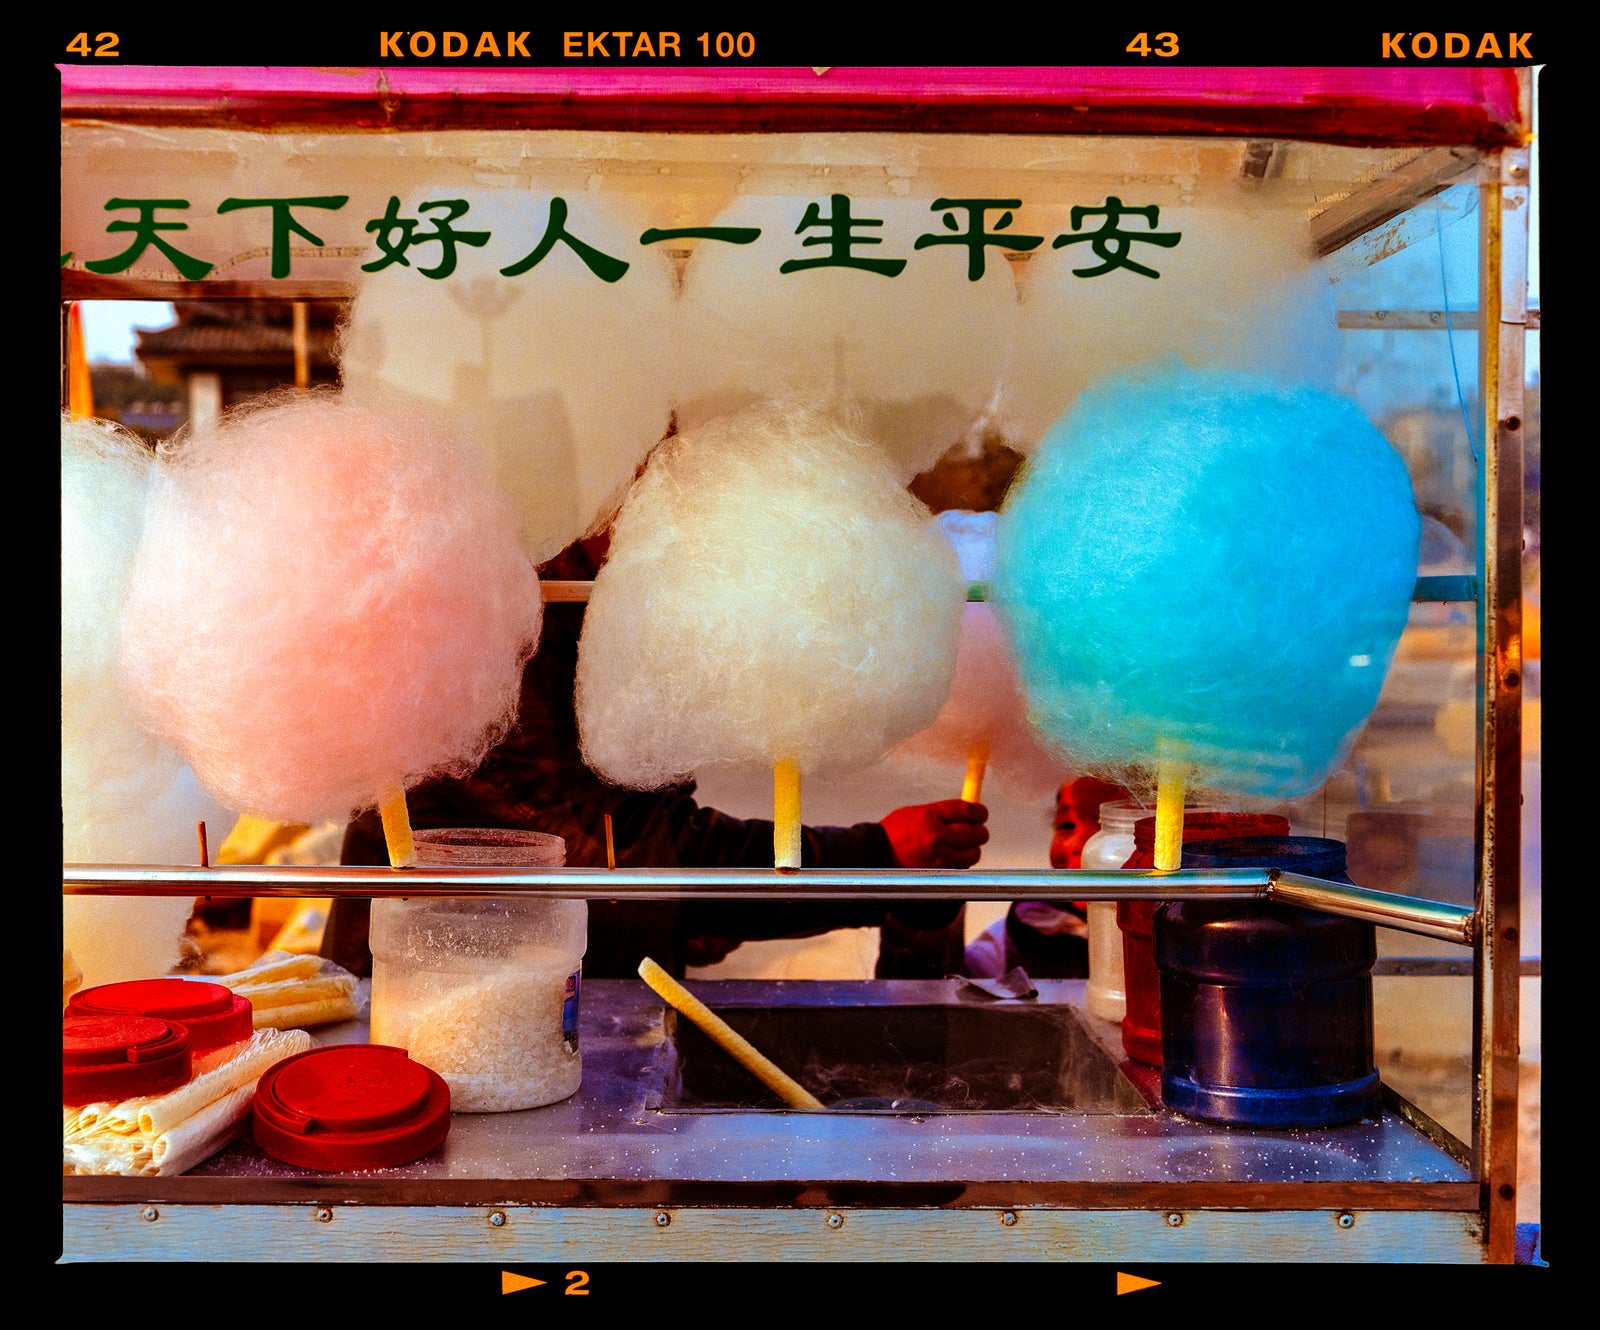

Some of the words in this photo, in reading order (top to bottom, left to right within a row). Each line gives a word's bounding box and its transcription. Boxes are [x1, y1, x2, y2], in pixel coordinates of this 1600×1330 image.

[61, 194, 1181, 283] 天下好人一生平安
